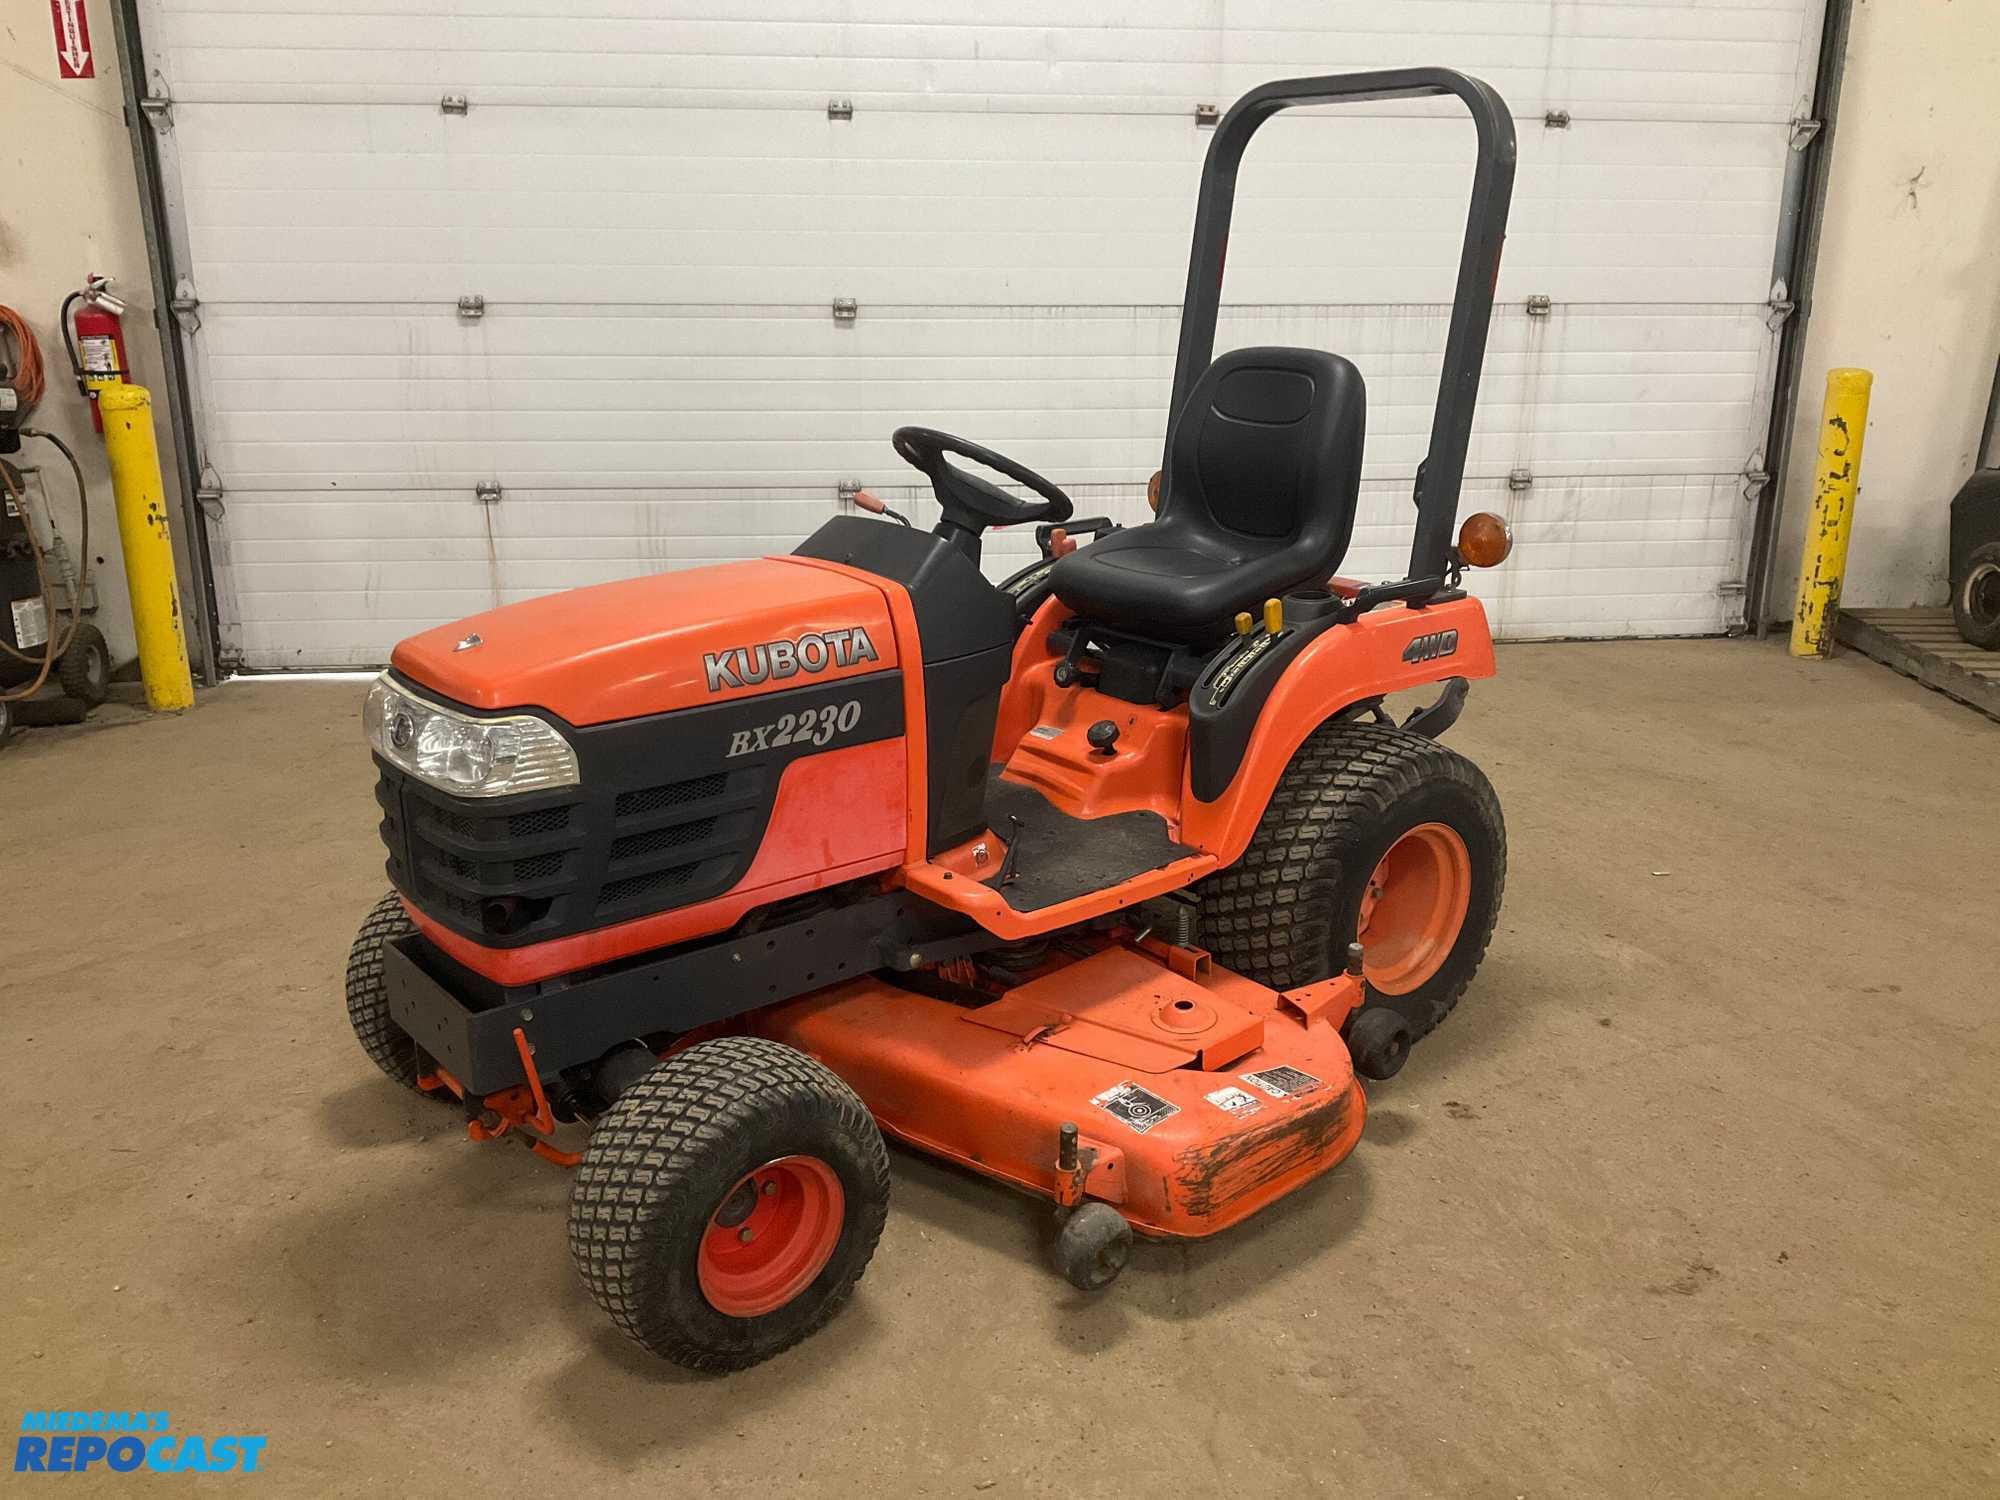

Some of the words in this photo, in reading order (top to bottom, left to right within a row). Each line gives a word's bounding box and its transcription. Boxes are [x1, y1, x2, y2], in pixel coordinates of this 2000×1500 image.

[703, 626, 879, 692] KUBOTA
[1402, 629, 1458, 664] 4WD
[725, 700, 862, 758] BX2230
